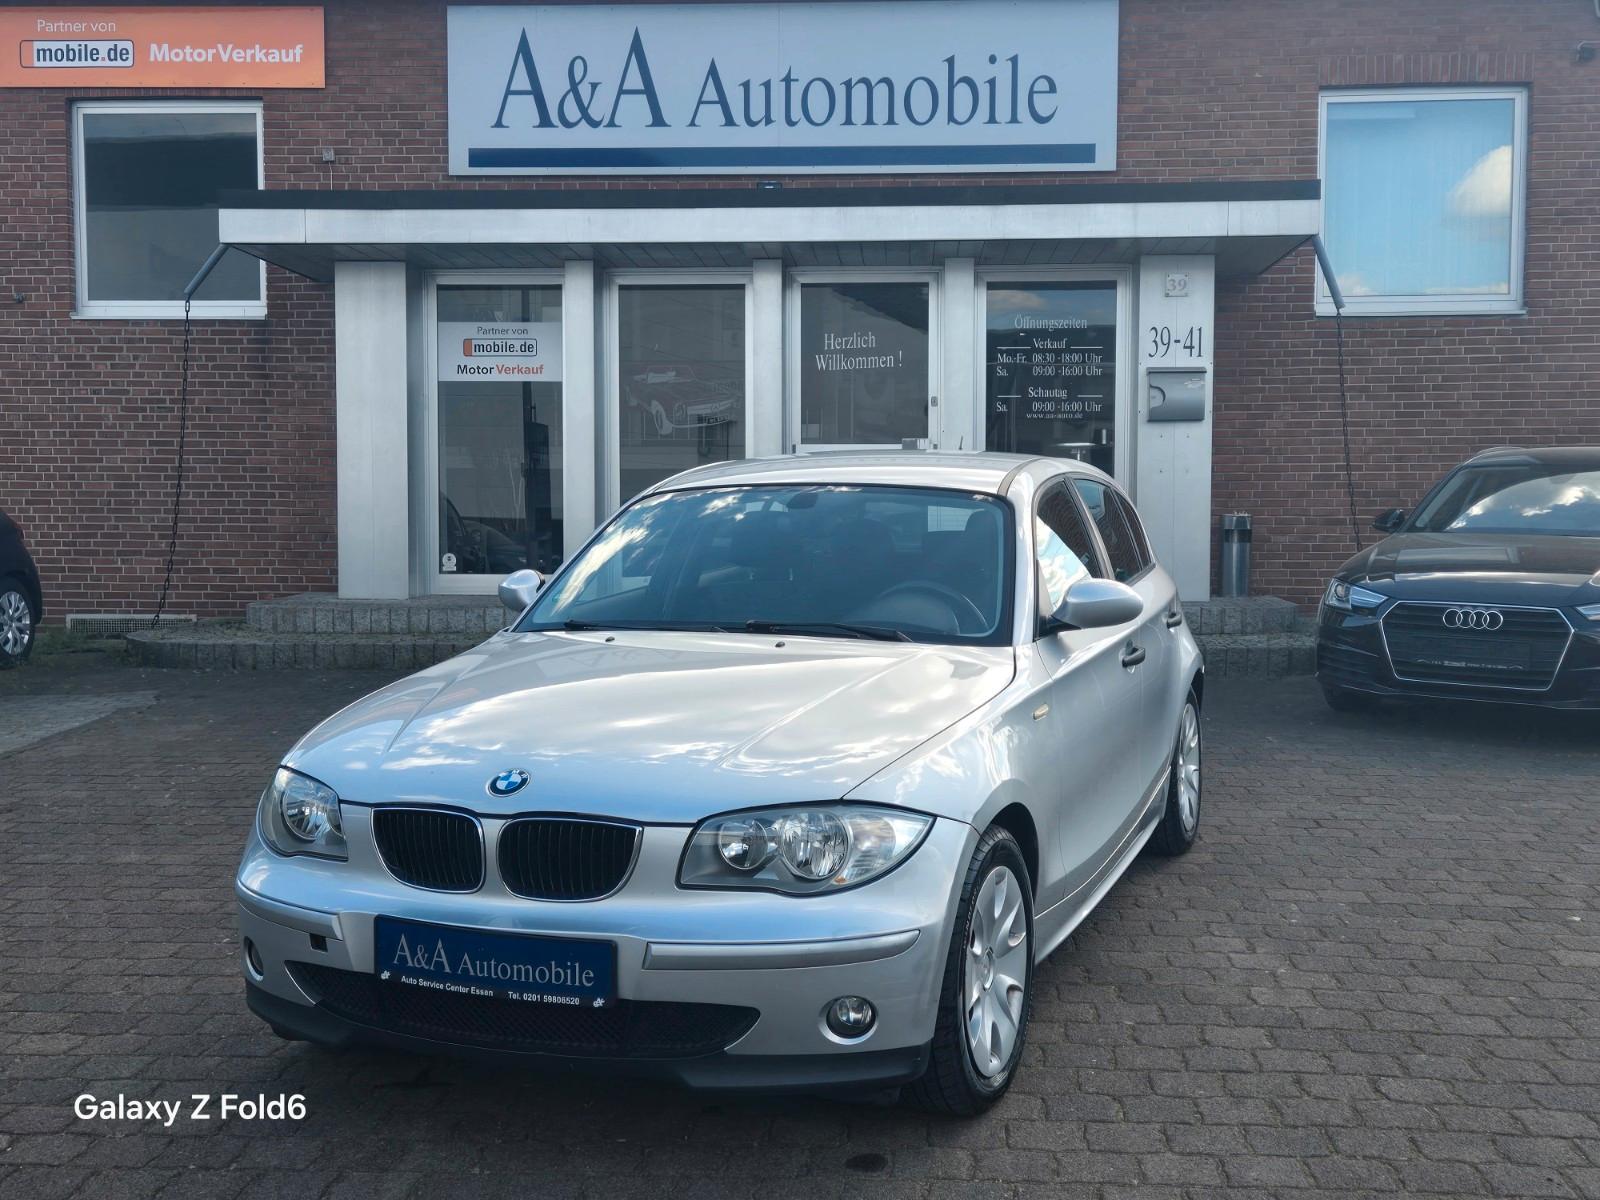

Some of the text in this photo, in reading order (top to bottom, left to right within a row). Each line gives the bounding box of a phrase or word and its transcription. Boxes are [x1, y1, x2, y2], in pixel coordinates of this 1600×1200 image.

[37, 19, 116, 33] Partner von
[35, 43, 130, 63] mobile.de
[490, 25, 1059, 130] A&A Automobile
[1168, 278, 1187, 292] 39
[1014, 314, 1088, 332] Öffnungszeiten
[477, 326, 529, 336] Partner von
[473, 341, 535, 353] mobile.de
[824, 331, 876, 350] Herzlich
[1033, 338, 1068, 349] Verkauf
[1148, 326, 1203, 358] 39-41
[815, 353, 894, 371] Willkommen
[1032, 353, 1055, 364] 08:30
[1085, 353, 1103, 364] Uhr
[996, 366, 1009, 376] Sa.
[1032, 366, 1056, 376] 09:00
[1085, 366, 1103, 376] Uhr
[1028, 387, 1068, 399] Schautag
[996, 401, 1008, 412] Sa.
[1032, 401, 1055, 412] 09:00
[1085, 401, 1103, 412] Uhr
[392, 933, 595, 987] A&A Automobile
[401, 975, 417, 985] Auto
[418, 978, 444, 990] Service
[445, 983, 470, 994] Center
[470, 986, 494, 997] Essen
[508, 991, 521, 1000] Tel.
[523, 992, 541, 1002] 0201
